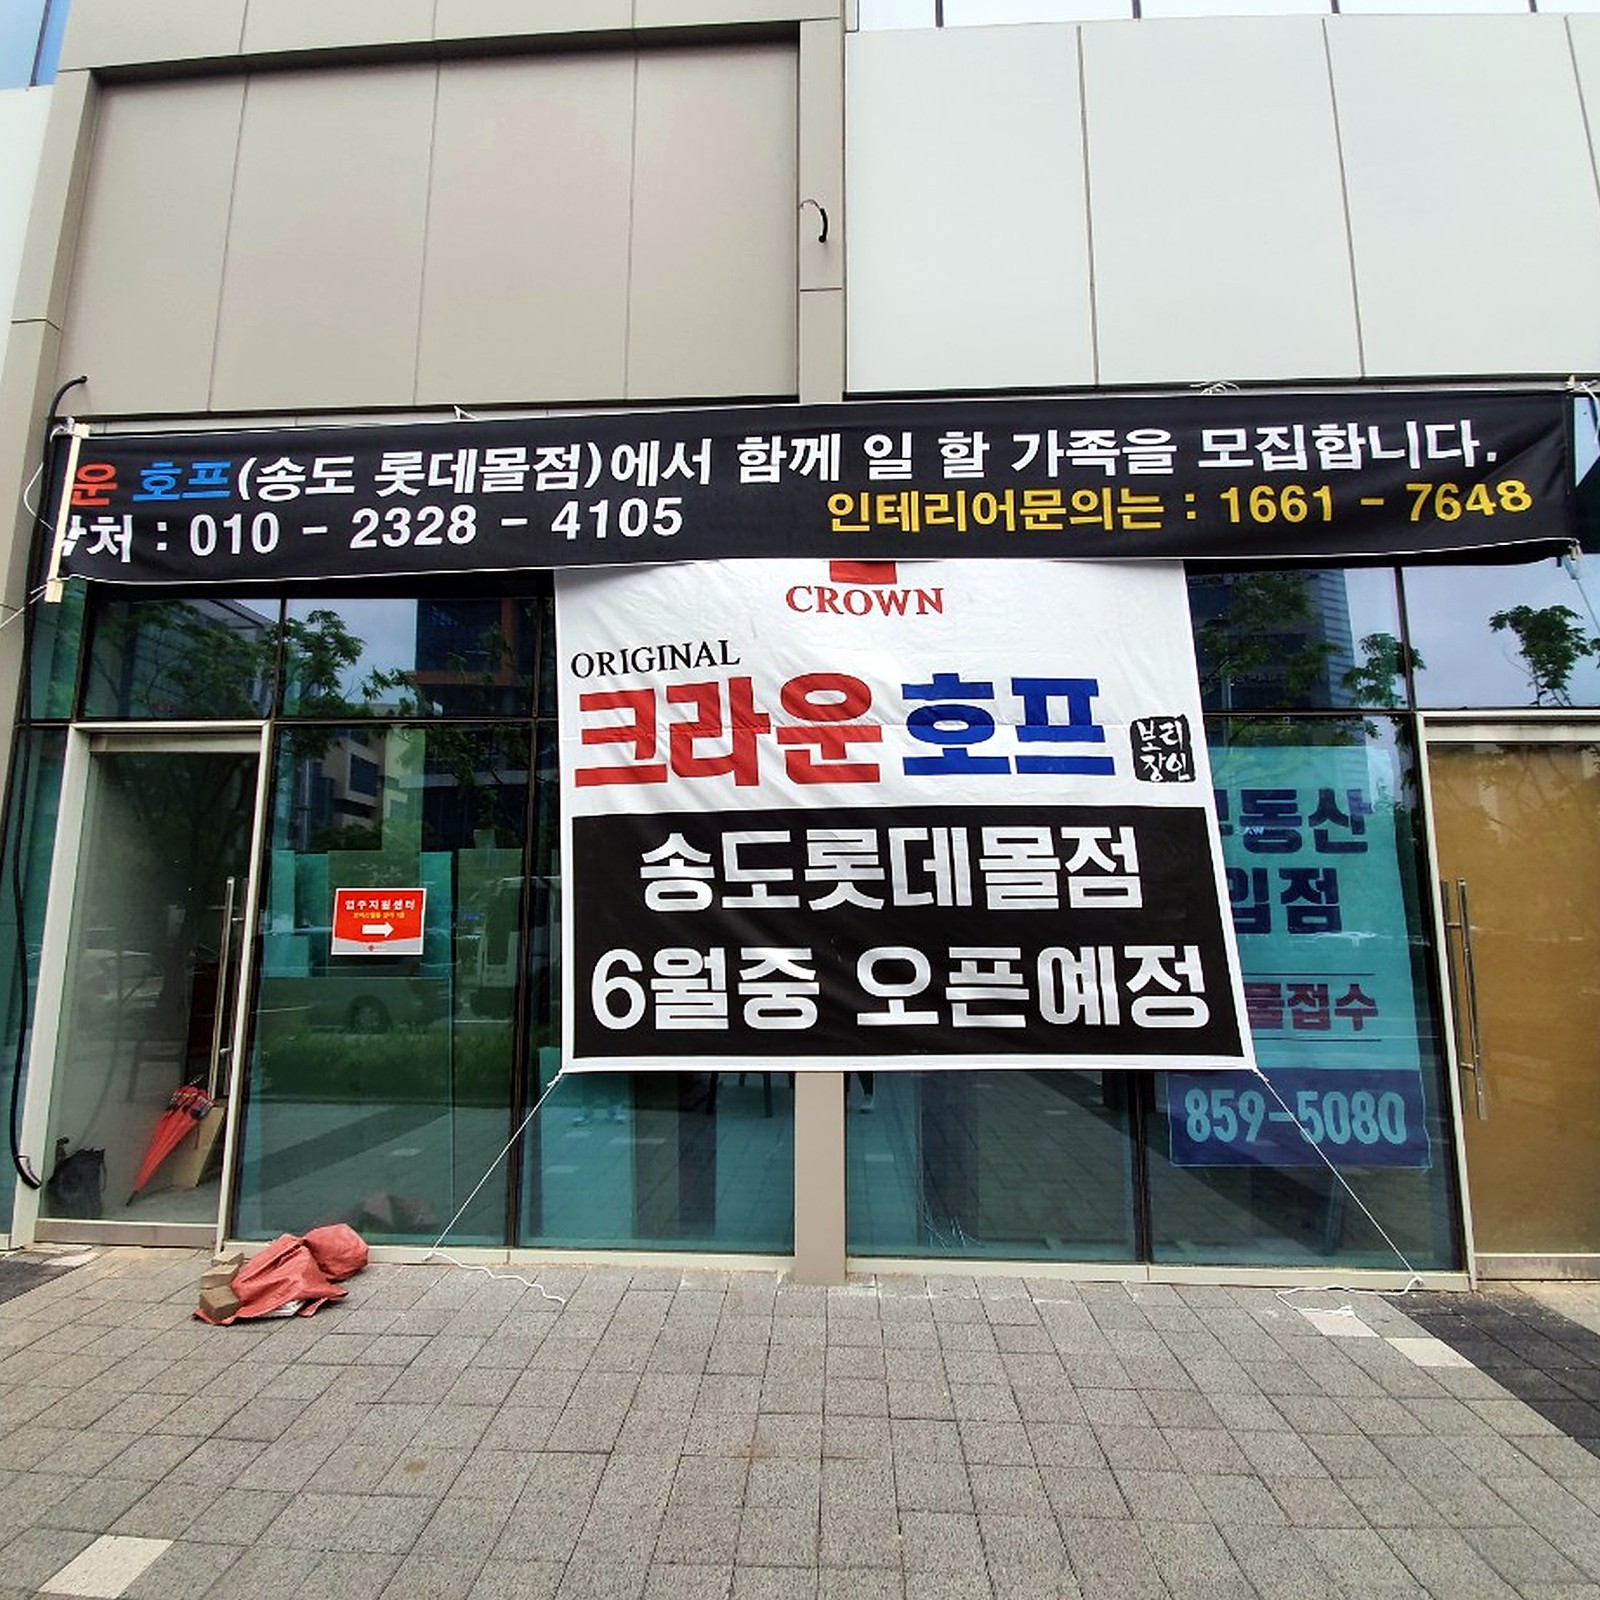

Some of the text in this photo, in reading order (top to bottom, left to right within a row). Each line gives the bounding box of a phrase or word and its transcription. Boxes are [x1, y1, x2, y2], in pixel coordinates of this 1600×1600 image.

[737, 433, 841, 484] 함께
[864, 431, 912, 481] 일
[938, 431, 990, 479] 할
[1012, 428, 1178, 478] 가족을
[1199, 418, 1497, 472] 모집합니다.
[190, 512, 279, 556] 010
[349, 504, 477, 549] 2328
[551, 497, 683, 540] 4105
[827, 487, 1165, 533] 인테리어문의는
[1220, 485, 1332, 524] 1661
[1407, 479, 1532, 521] 7648
[786, 586, 943, 616] CROWN
[571, 639, 741, 678] ORIGINAL
[575, 672, 1116, 788] 크라운 호프
[1136, 720, 1182, 752] 보리
[1140, 752, 1190, 782] 장인
[640, 826, 1143, 912] 송도롯데몰점
[591, 945, 1210, 1030] 6월중 오픈예정
[1185, 1090, 1407, 1145] 859-5080
